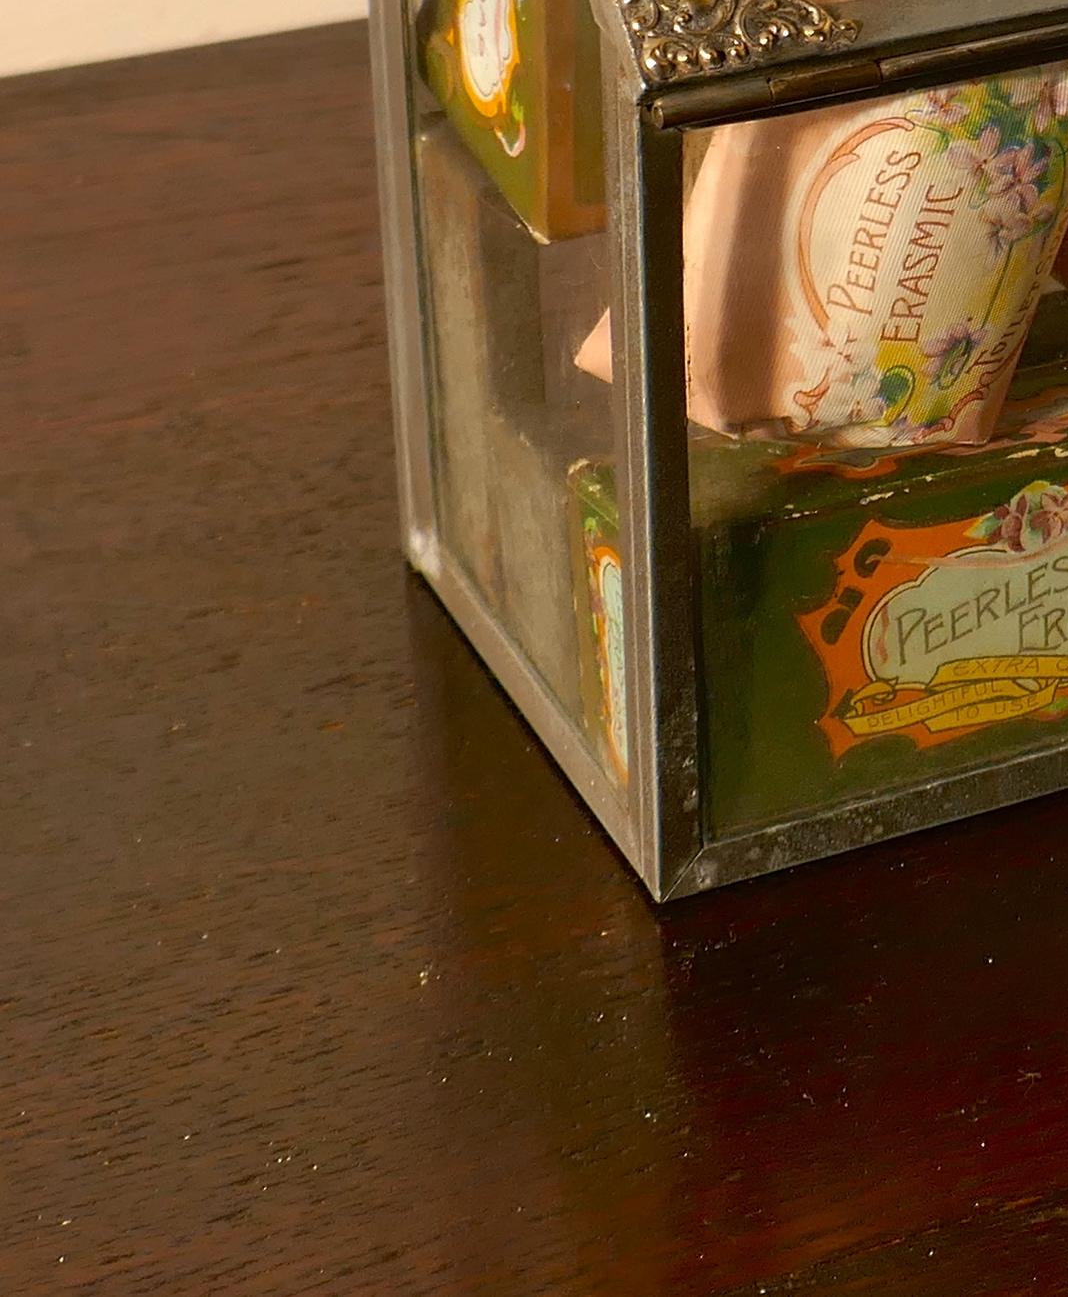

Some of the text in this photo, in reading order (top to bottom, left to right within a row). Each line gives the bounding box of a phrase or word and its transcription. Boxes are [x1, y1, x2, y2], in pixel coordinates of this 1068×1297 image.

[827, 150, 922, 316] PEERLESS
[880, 183, 965, 345] ERASMIC
[953, 658, 1041, 677] EXTRA
